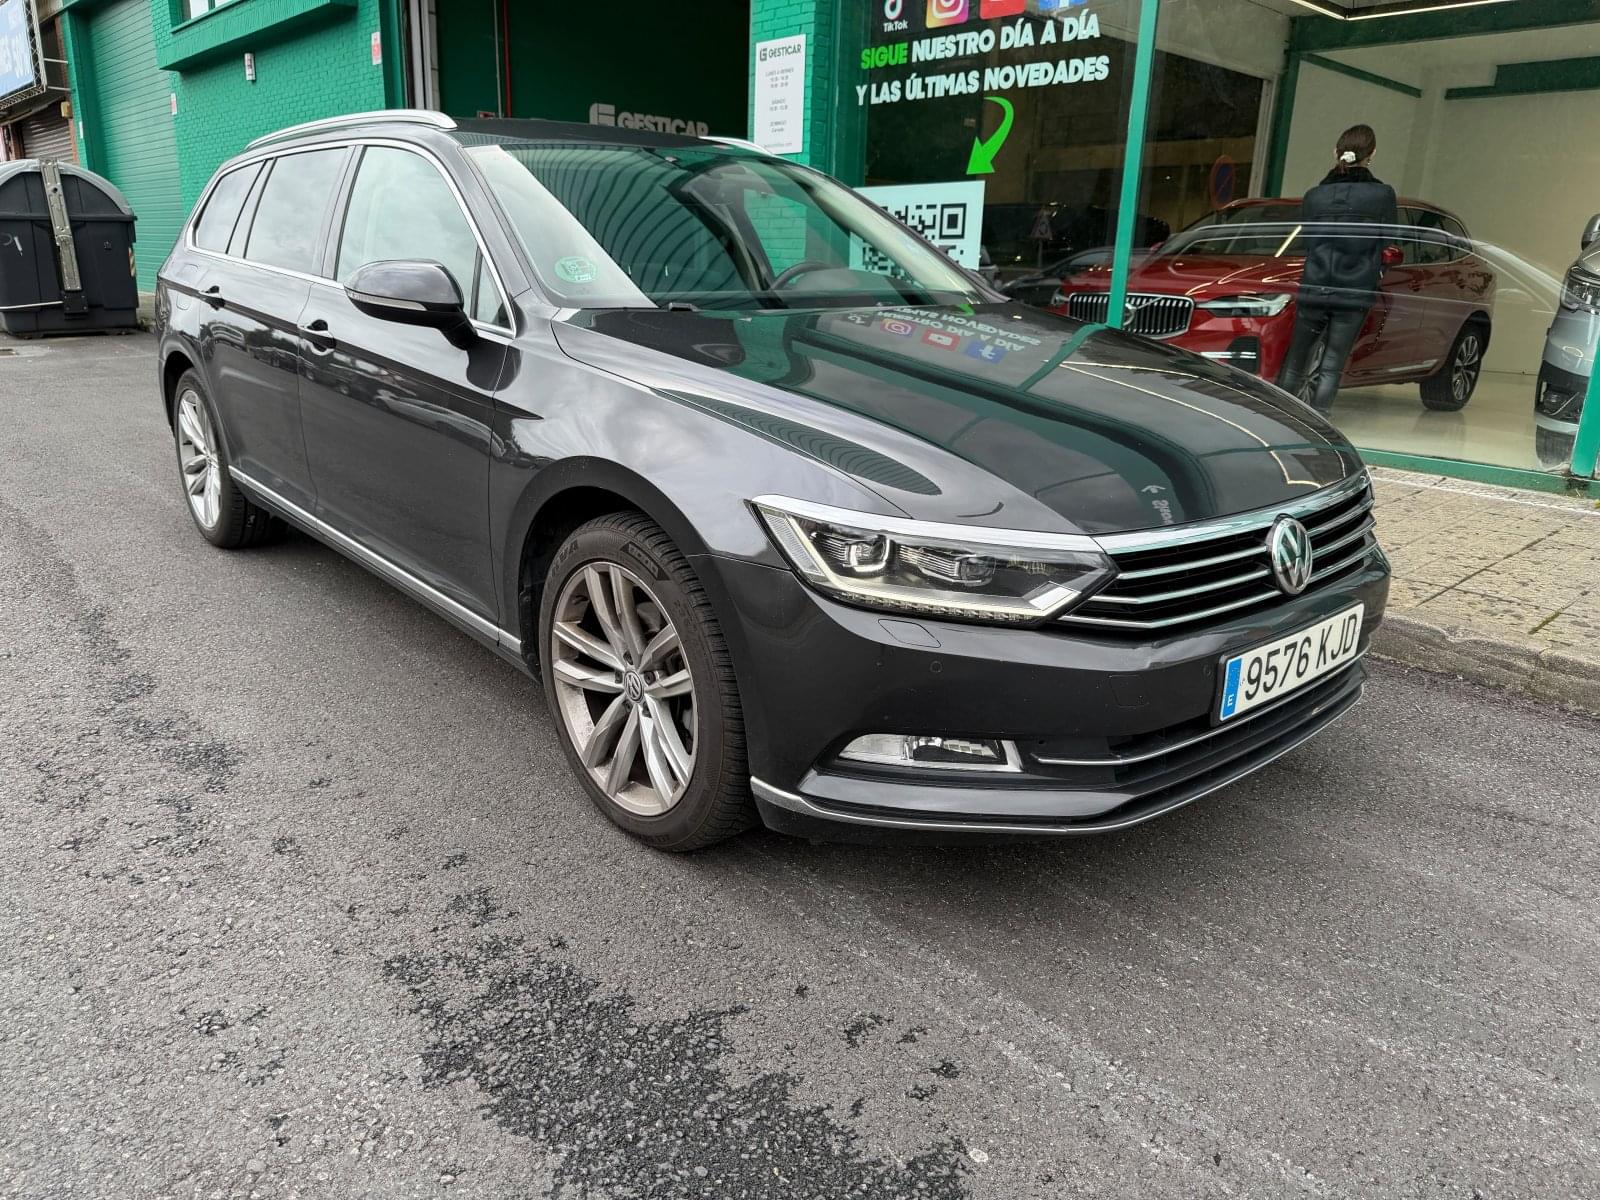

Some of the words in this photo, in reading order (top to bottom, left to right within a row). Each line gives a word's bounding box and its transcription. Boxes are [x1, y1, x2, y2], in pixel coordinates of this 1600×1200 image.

[861, 42, 908, 70] SIGUE
[911, 31, 995, 63] NUESTRO
[1000, 18, 1034, 50] DÍA
[1040, 20, 1057, 45] A
[1062, 9, 1101, 41] DÍA
[883, 20, 908, 32] TikTok
[768, 43, 802, 59] GESTICAR
[856, 85, 868, 106] Y
[871, 80, 901, 105] LAS
[905, 73, 980, 100] ÚLTIMAS
[983, 55, 1110, 92] NOVEDADES
[1245, 636, 1312, 701] 9576
[1316, 613, 1358, 670] KJD
[1227, 693, 1235, 707] E
